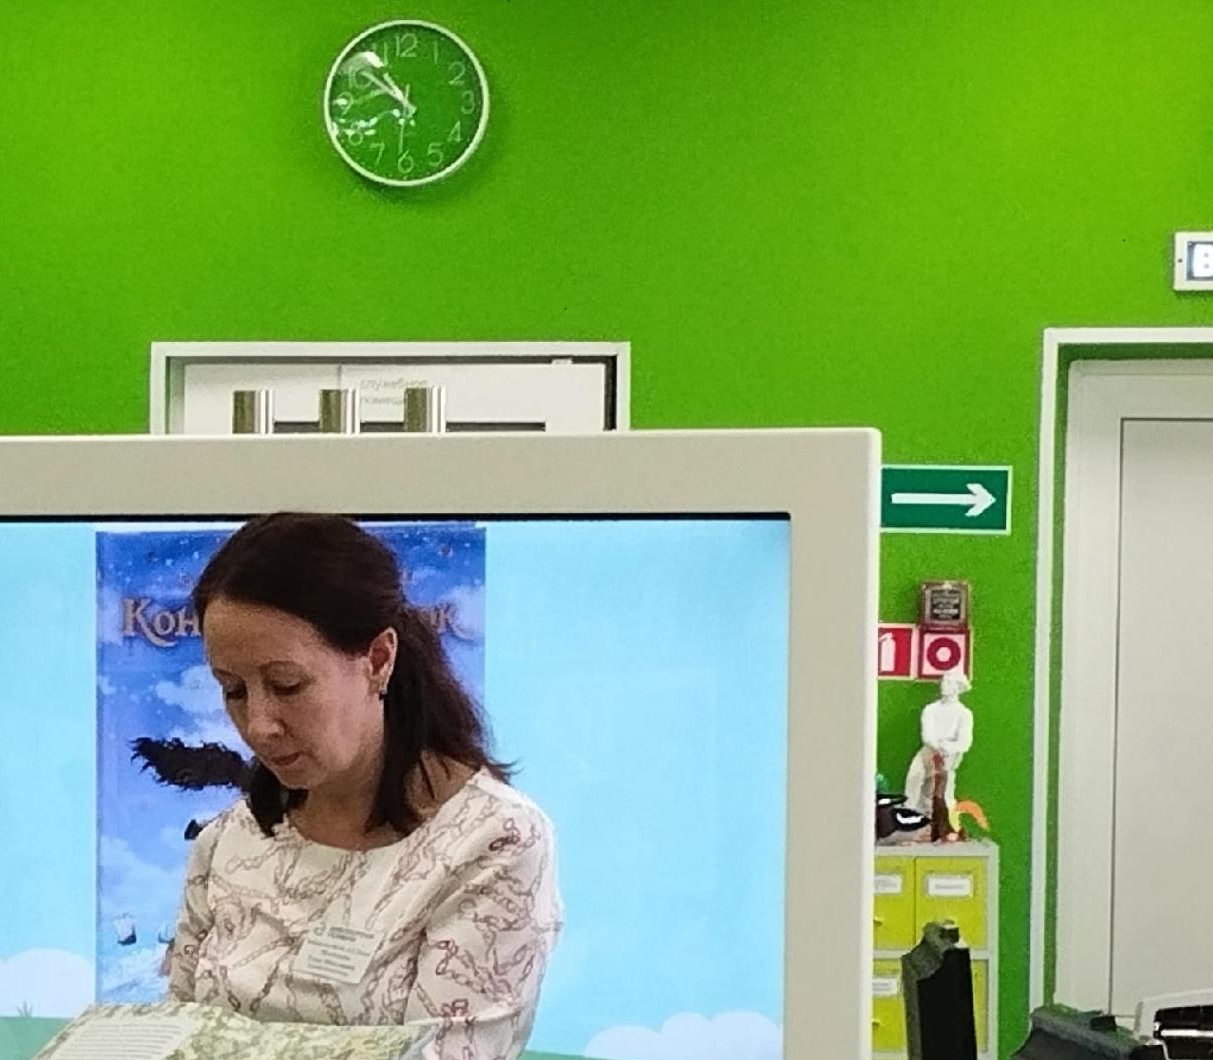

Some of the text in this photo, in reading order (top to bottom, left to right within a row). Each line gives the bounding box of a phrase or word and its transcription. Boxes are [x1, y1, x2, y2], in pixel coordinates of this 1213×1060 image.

[395, 33, 418, 58] 12
[448, 61, 467, 86] 2
[461, 90, 475, 115] 3
[447, 120, 462, 143] 4
[370, 142, 385, 166] 7
[397, 149, 414, 174] 6
[426, 142, 443, 167] 5
